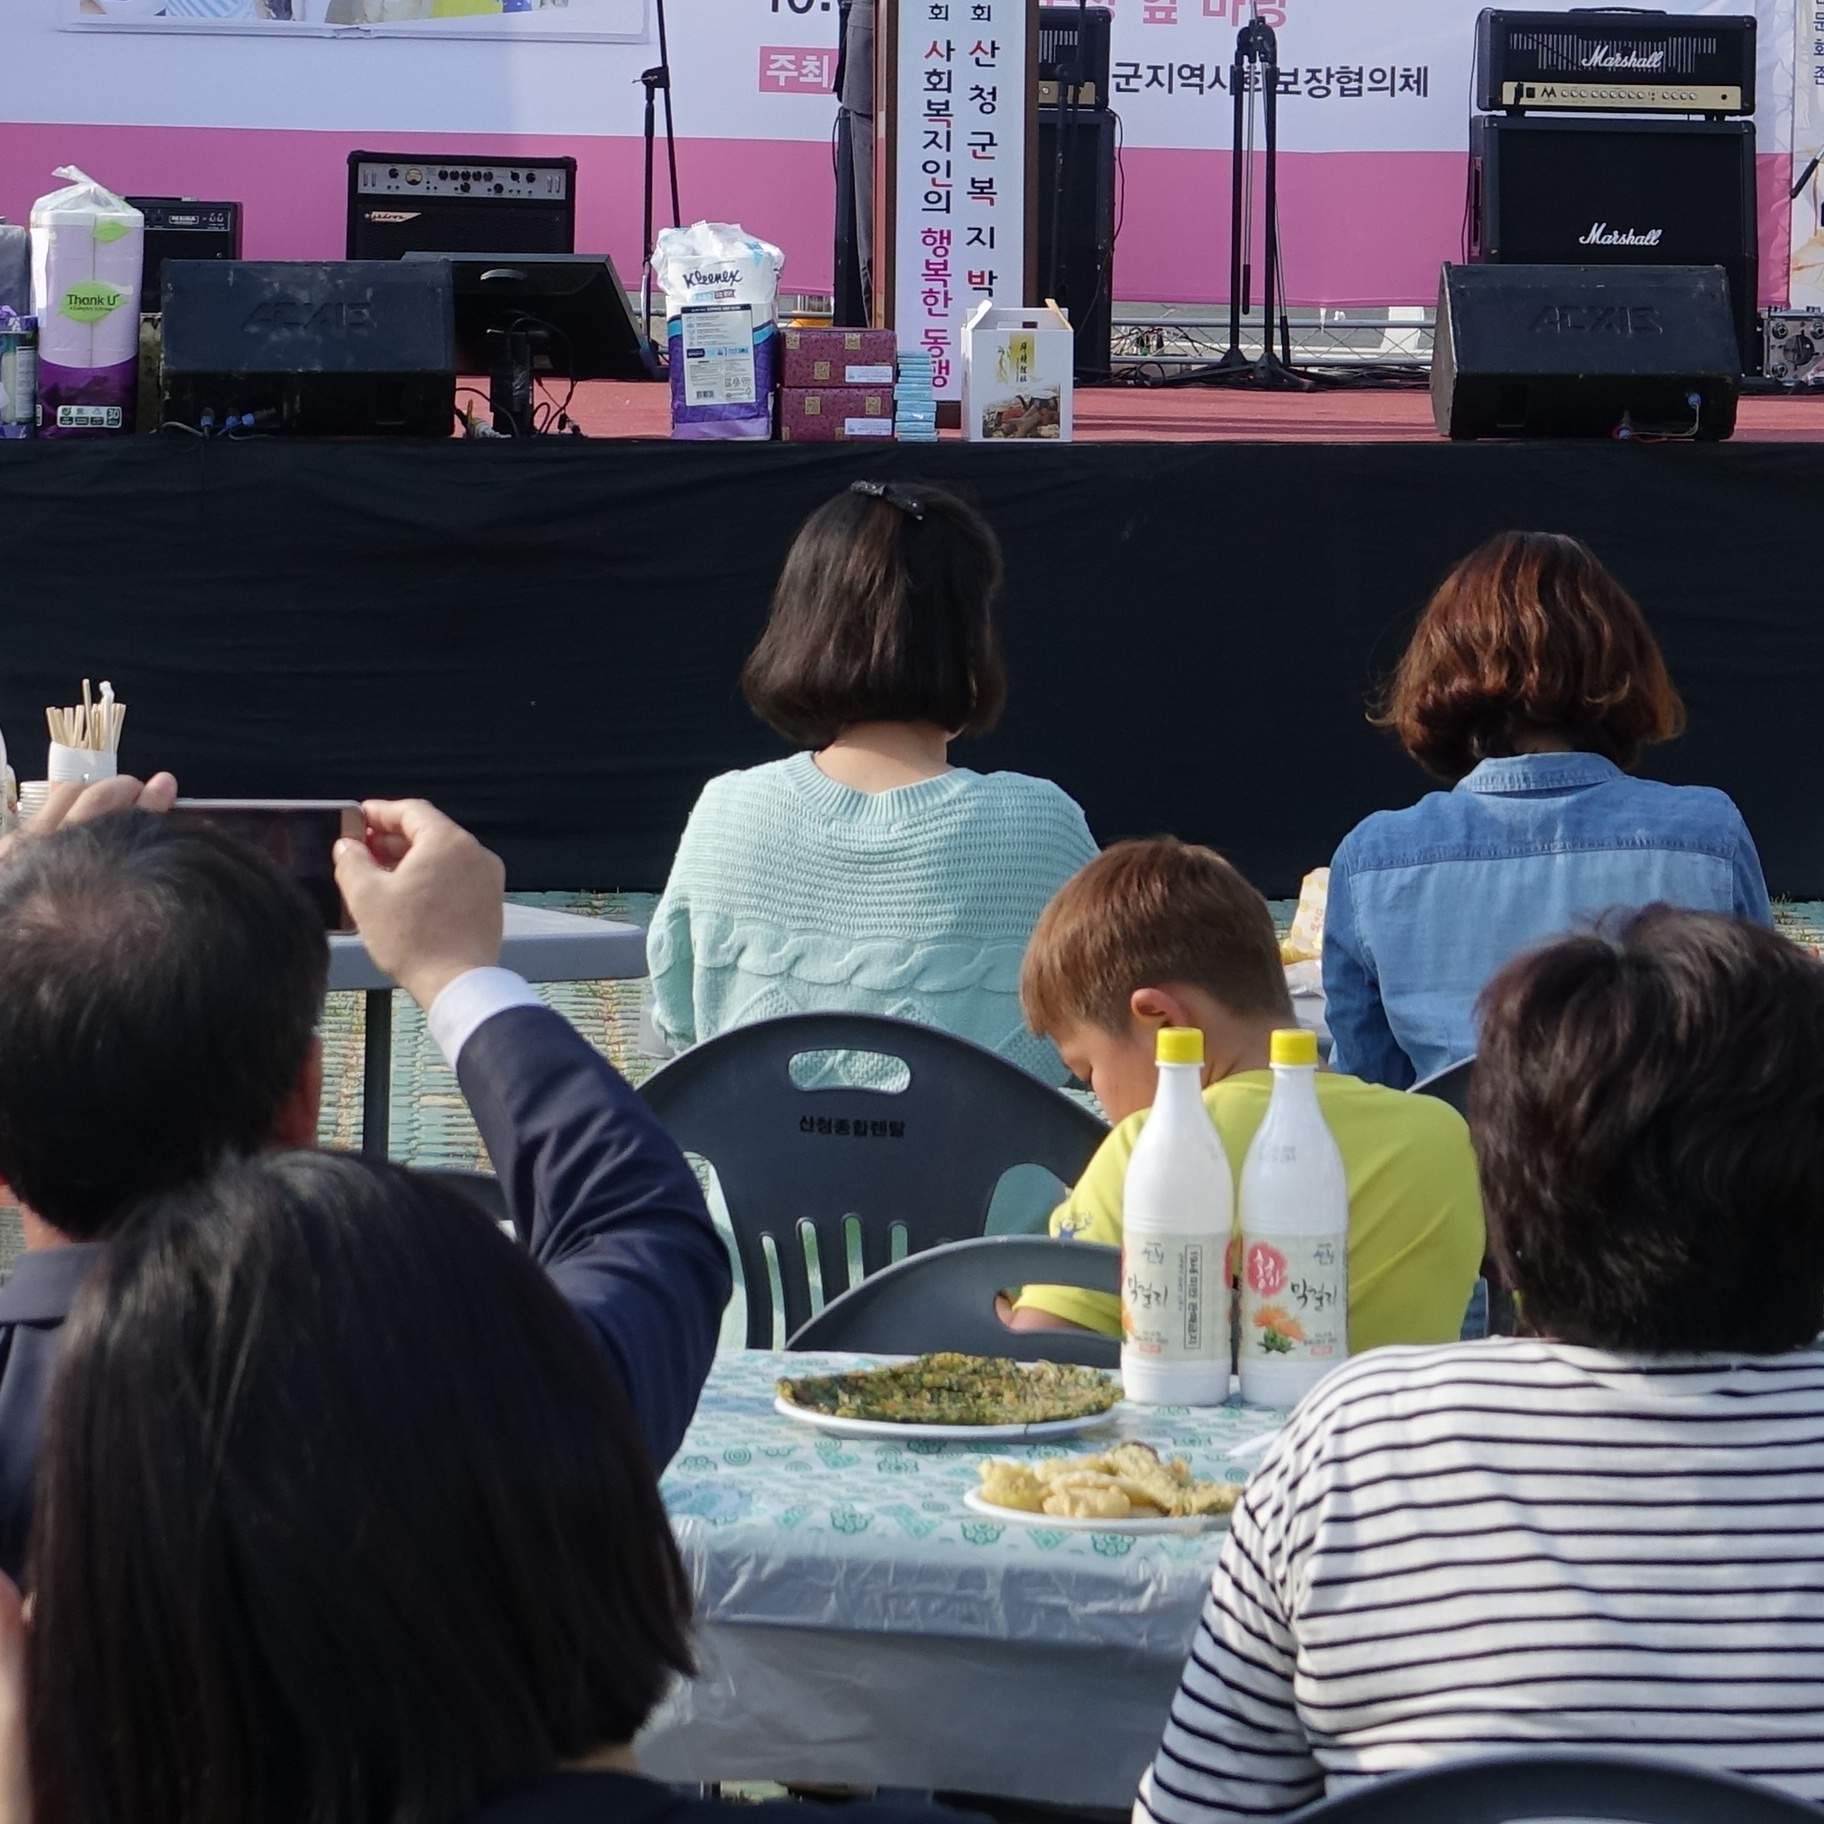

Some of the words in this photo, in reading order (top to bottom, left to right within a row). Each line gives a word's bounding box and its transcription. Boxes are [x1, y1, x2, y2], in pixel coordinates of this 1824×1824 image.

[1581, 45, 1664, 69] Marshall
[921, 39, 955, 215] 사회복지인의
[1579, 221, 1663, 247] Marshall
[683, 268, 743, 289] Kleenex
[920, 227, 953, 319] 행복한
[66, 294, 105, 306] Thank
[800, 1115, 905, 1138] 산청종합렌탈
